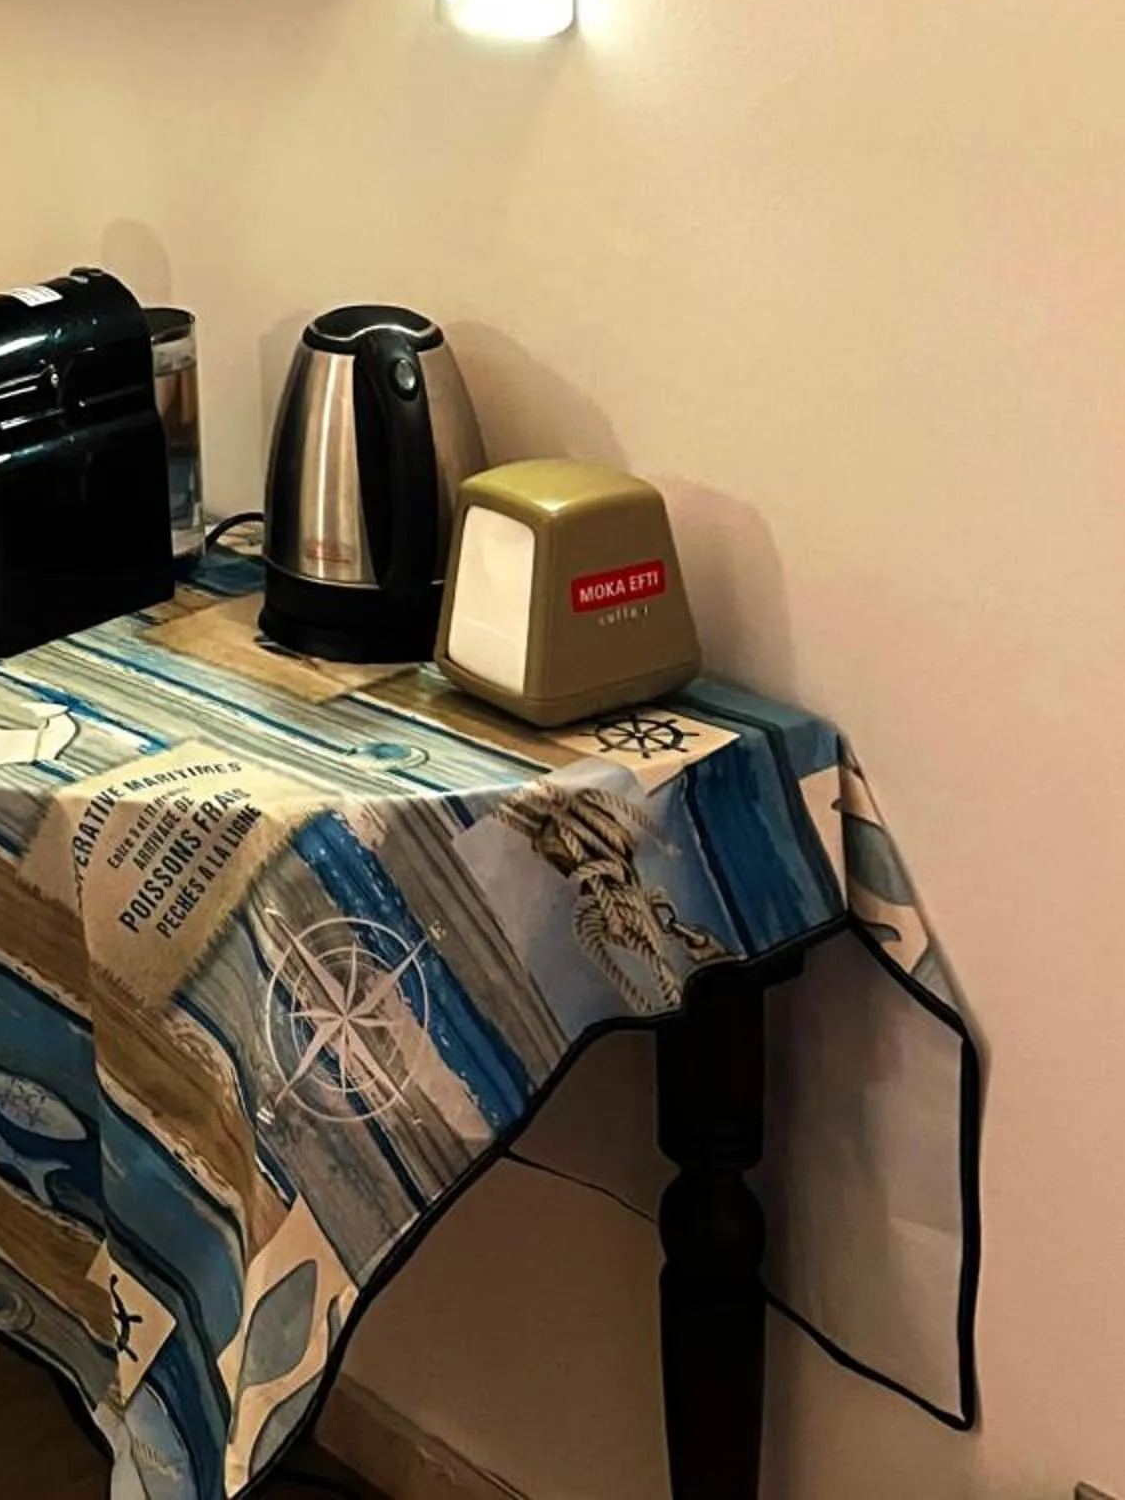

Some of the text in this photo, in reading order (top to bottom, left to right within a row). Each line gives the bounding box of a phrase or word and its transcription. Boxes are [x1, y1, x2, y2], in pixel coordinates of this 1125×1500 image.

[578, 571, 658, 604] MOKA EFTI
[122, 761, 242, 792] MARITIMES
[133, 809, 181, 871] ARRIVAGE
[205, 845, 232, 869] LA
[220, 803, 262, 849] LIGNE
[118, 829, 202, 934] POISSONS
